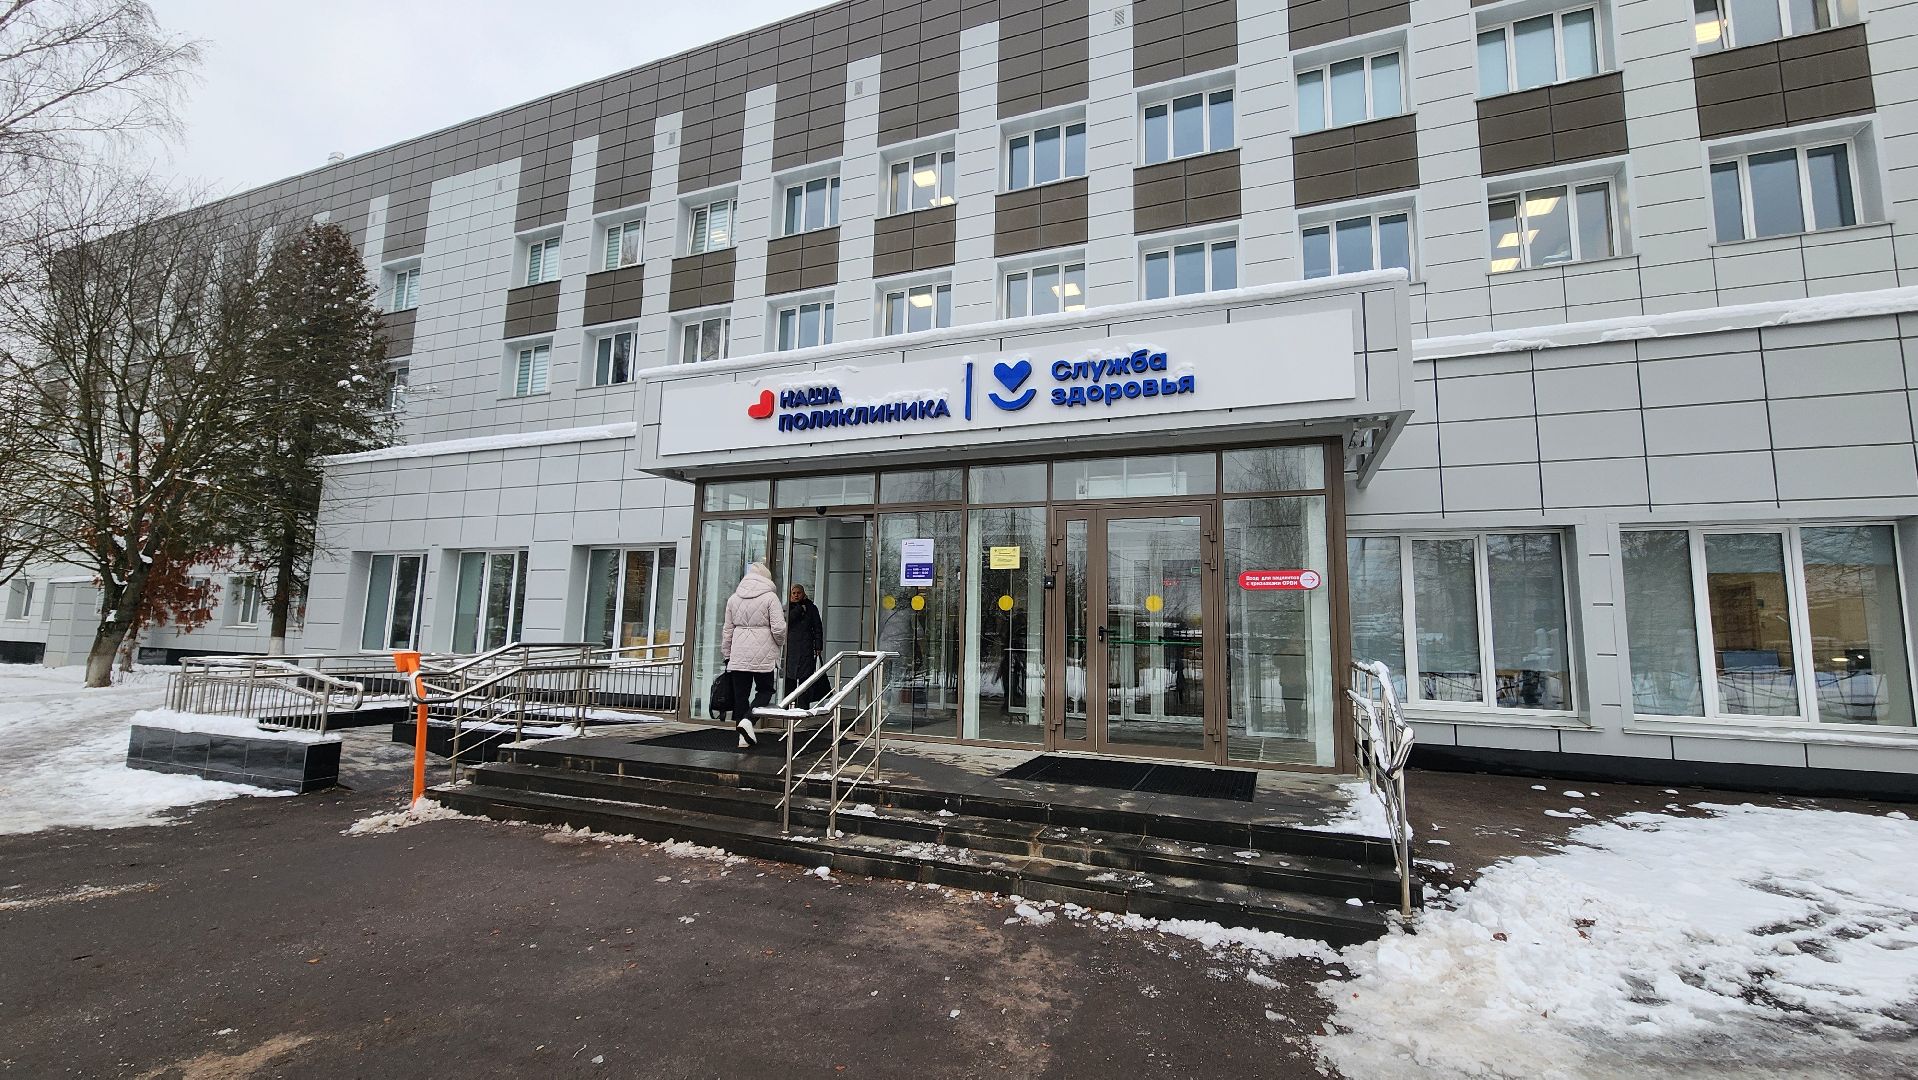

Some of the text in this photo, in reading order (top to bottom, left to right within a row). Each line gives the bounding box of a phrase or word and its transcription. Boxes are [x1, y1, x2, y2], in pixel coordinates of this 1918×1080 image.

[1051, 348, 1168, 383] Служба
[779, 386, 843, 409] НАША
[1050, 375, 1195, 407] здоровья
[778, 398, 951, 433] ПОЛИКЛИНИКА
